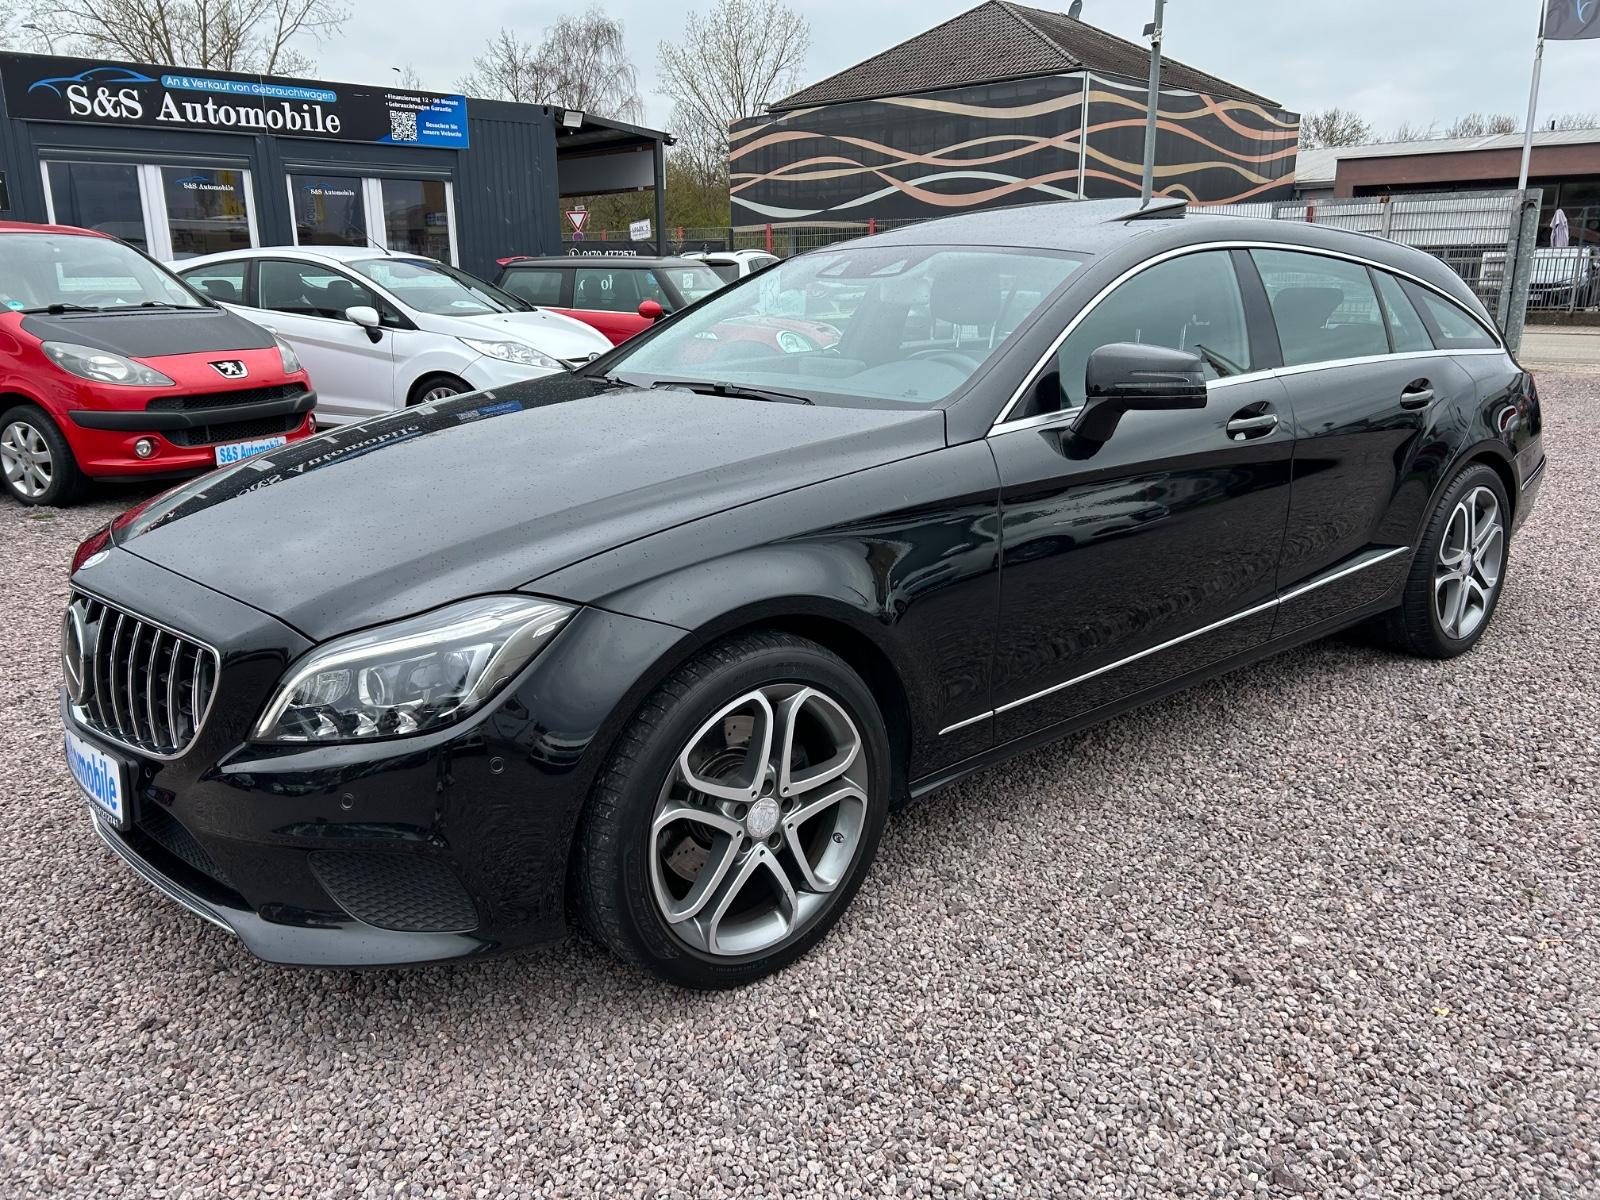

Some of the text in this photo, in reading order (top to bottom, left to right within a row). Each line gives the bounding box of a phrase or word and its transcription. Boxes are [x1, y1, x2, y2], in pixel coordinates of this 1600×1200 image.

[166, 76, 334, 101] An & Verkauf von Gebrauchtwagen
[66, 84, 341, 133] S&S Automobile
[183, 182, 235, 192] S&S Automobile
[219, 439, 284, 463] S&S Automobil
